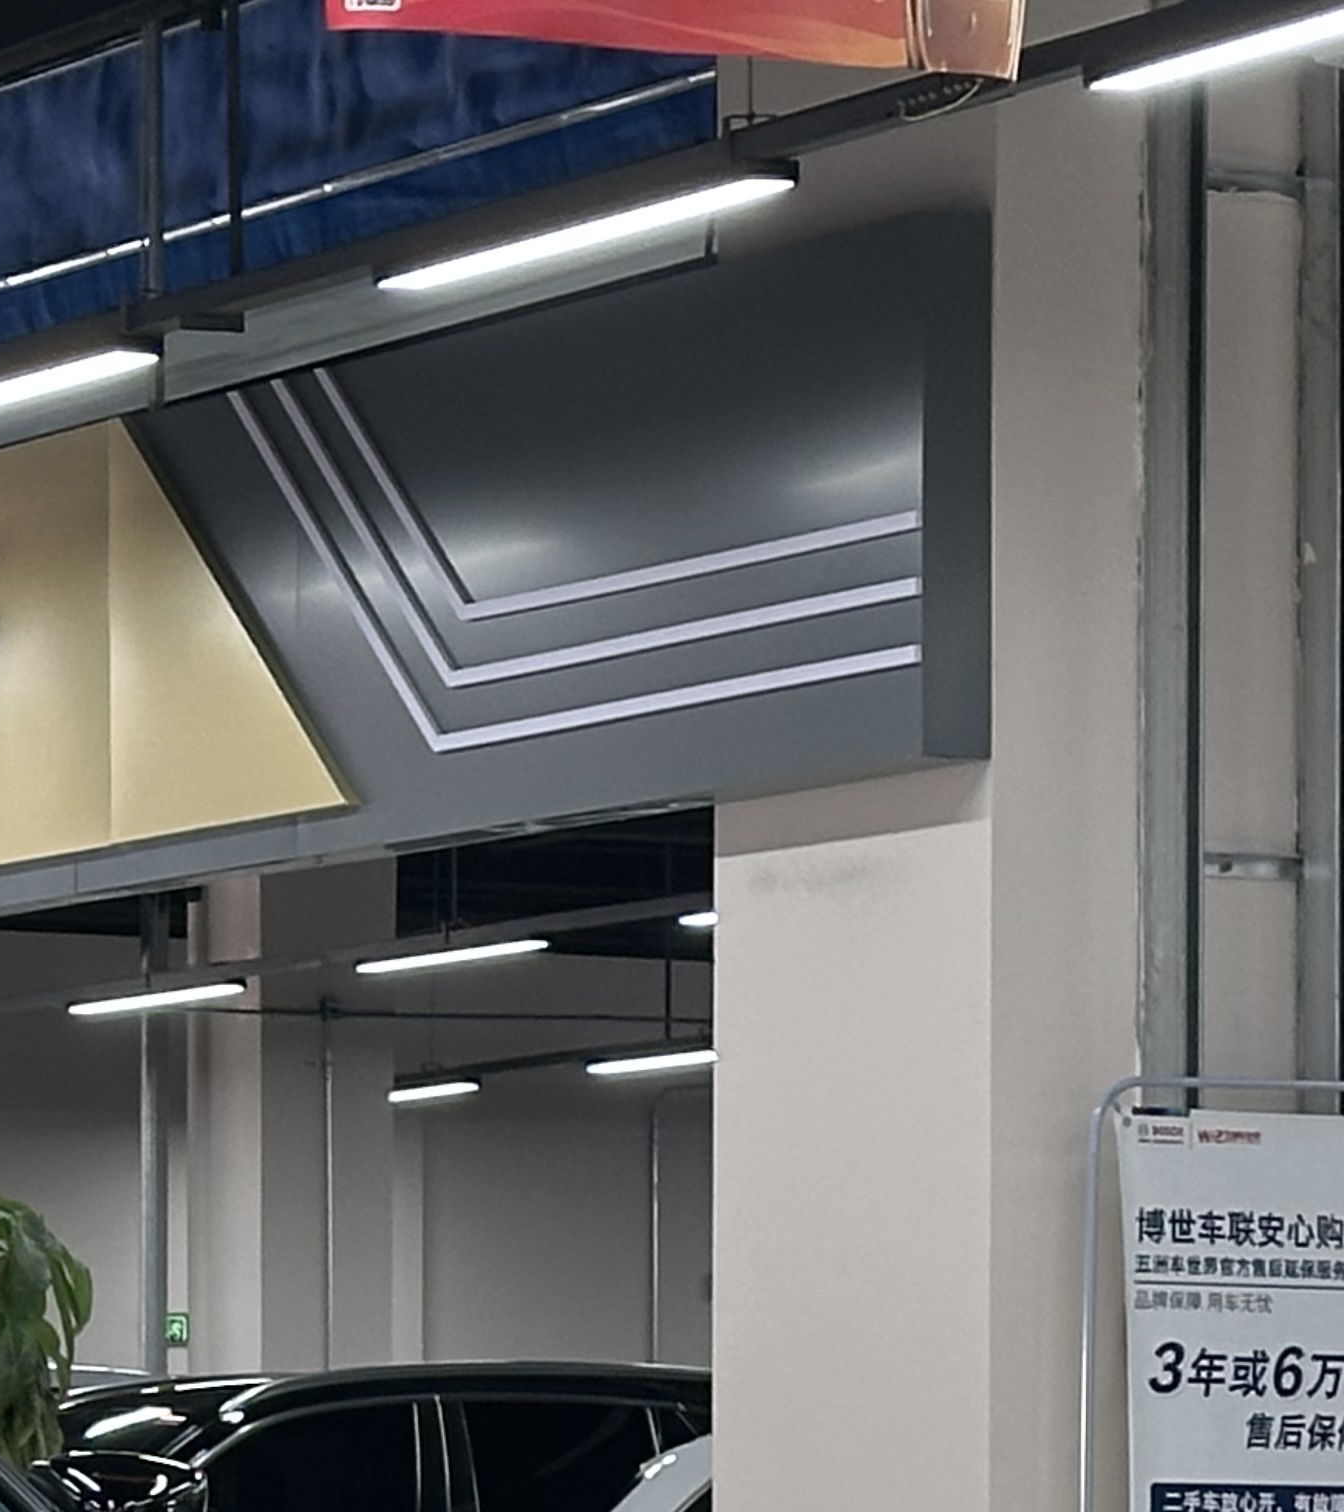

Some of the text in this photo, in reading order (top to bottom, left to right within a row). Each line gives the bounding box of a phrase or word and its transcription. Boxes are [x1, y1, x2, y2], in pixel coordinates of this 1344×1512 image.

[1135, 1207, 1344, 1250] 博世车联安心购
[1148, 1341, 1344, 1400] 3年或6万
[1245, 1412, 1344, 1451] 售后保
